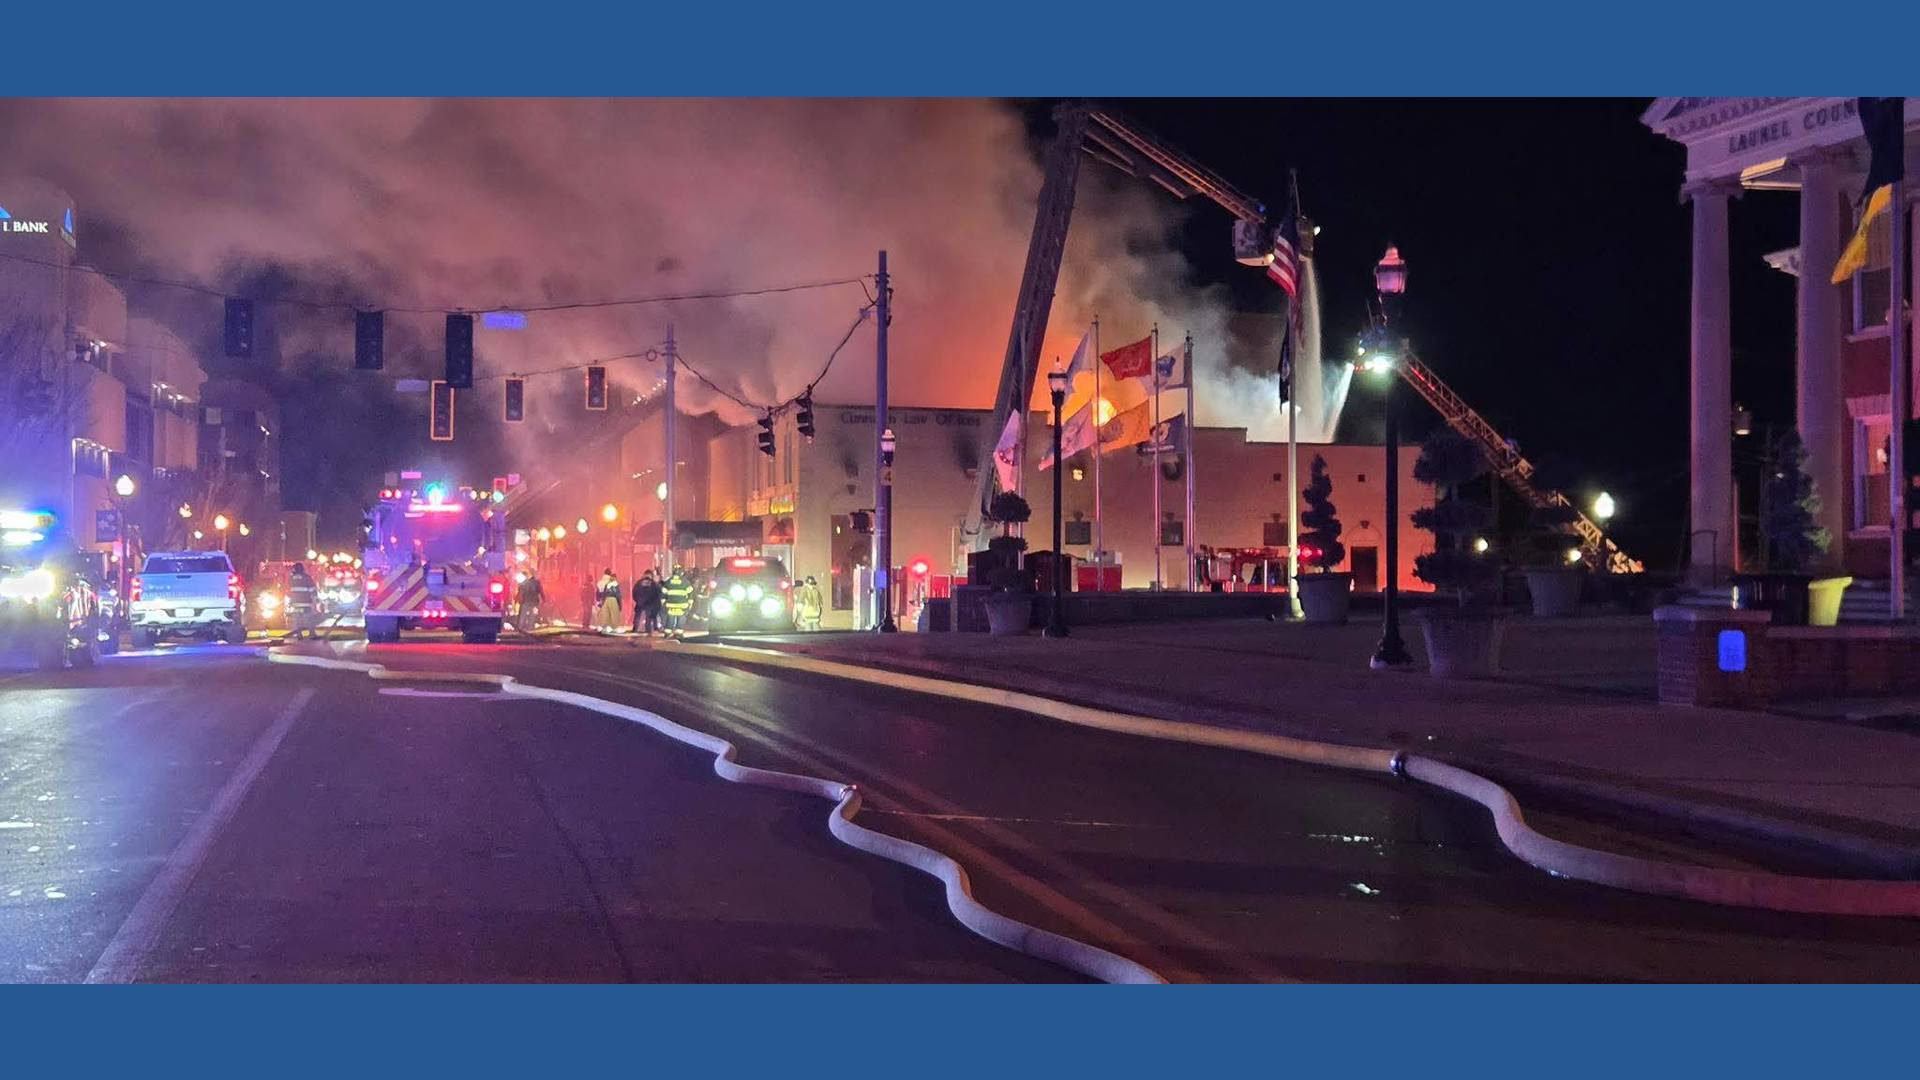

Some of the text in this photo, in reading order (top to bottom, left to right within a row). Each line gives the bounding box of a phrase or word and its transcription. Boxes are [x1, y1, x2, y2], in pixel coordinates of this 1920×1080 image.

[1729, 99, 1858, 153] LAUREL COUN
[13, 221, 48, 232] BANK
[904, 413, 928, 424] Law
